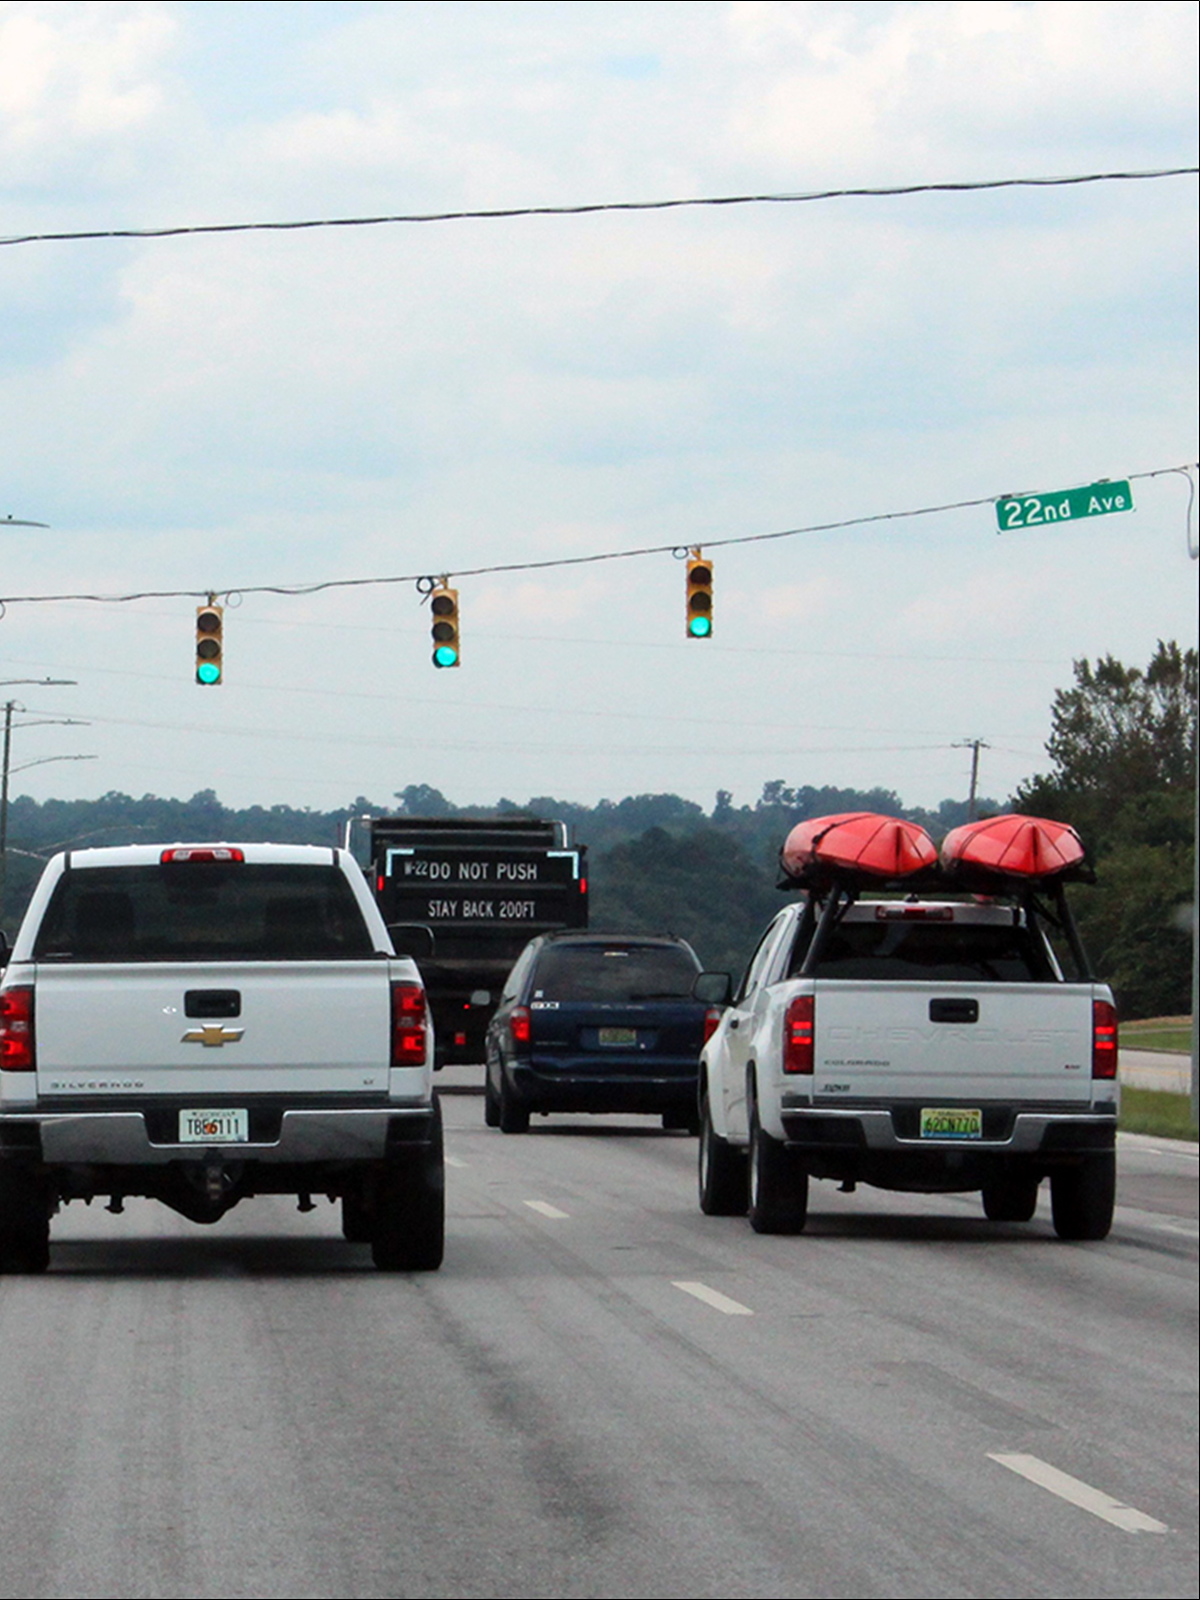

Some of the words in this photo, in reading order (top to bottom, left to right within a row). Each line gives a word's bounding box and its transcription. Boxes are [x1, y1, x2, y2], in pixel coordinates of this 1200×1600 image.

[1004, 498, 1071, 527] 22nd
[1088, 495, 1125, 513] Ave
[429, 863, 451, 879] DO
[458, 863, 490, 879] NOT
[496, 863, 538, 880] PUSH
[428, 901, 457, 917] STAY
[462, 901, 494, 917] BACK
[499, 901, 536, 918] 200FT
